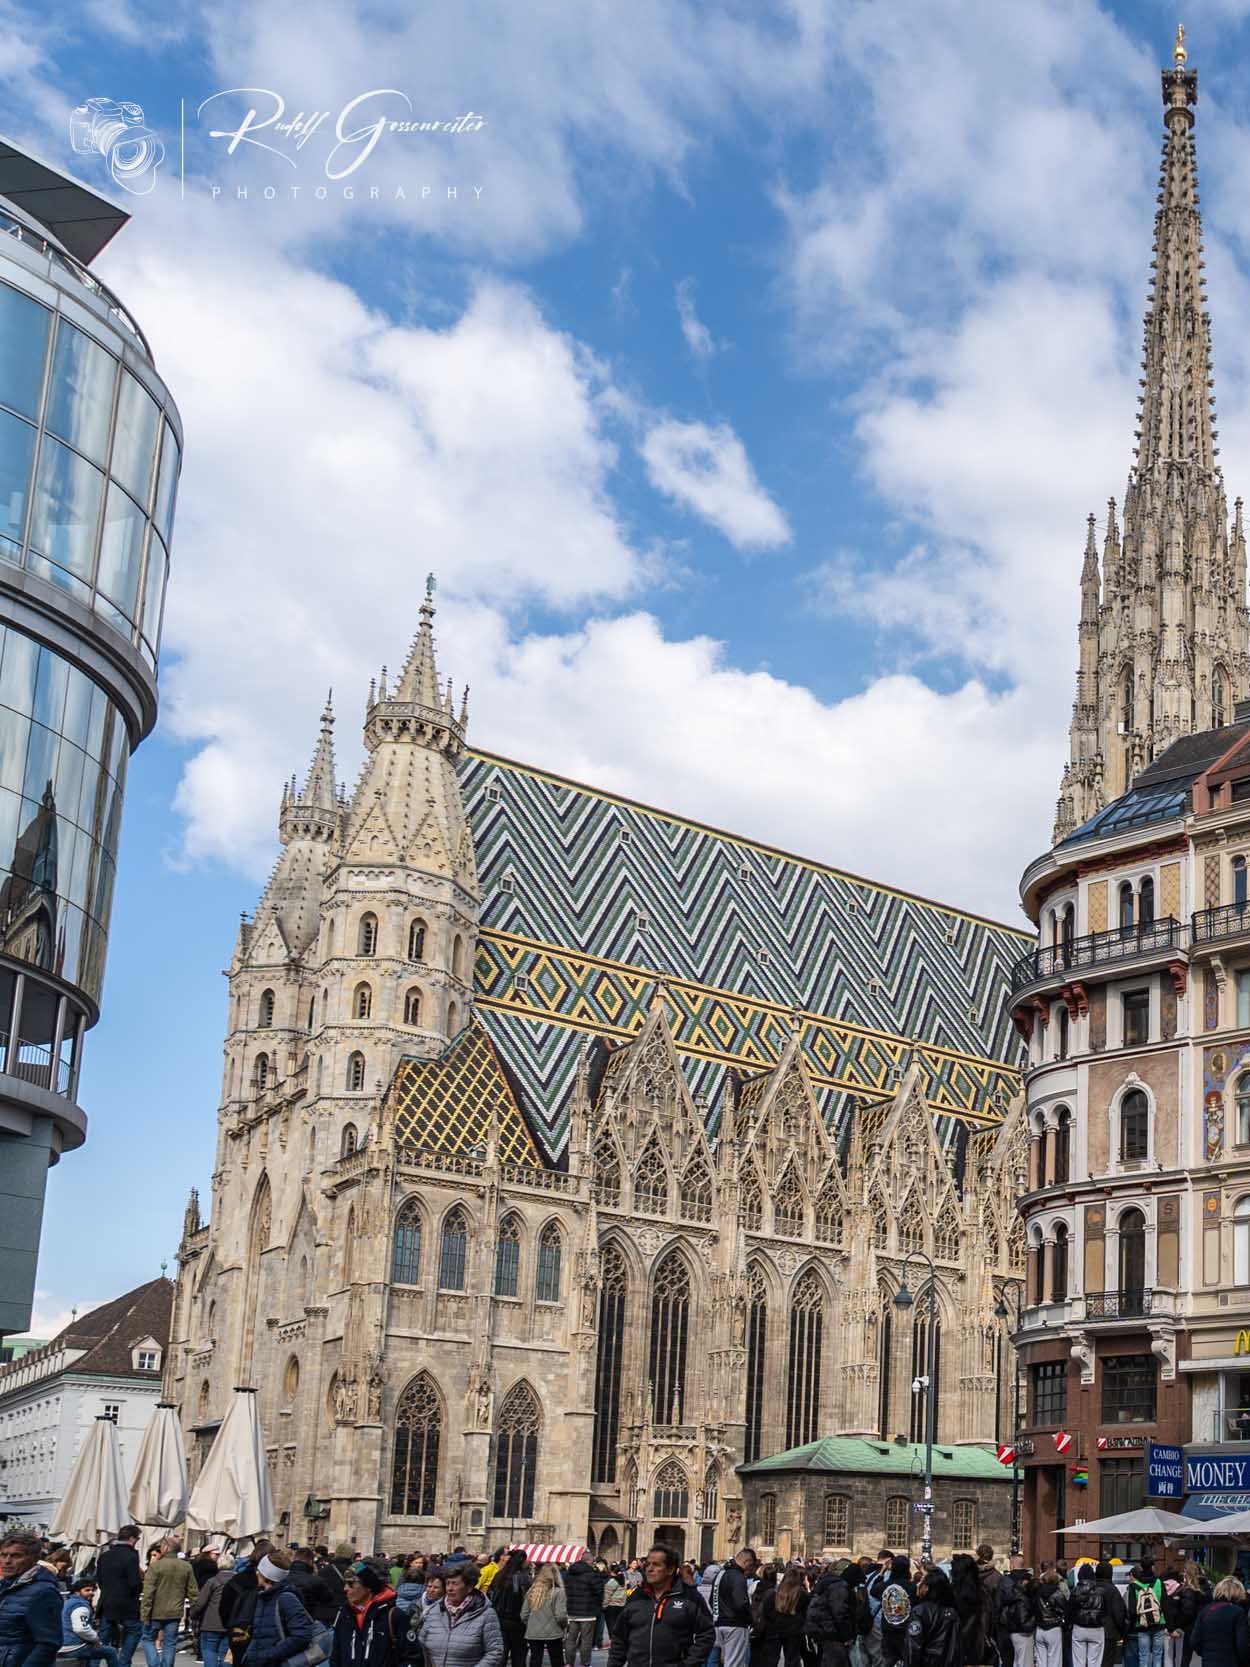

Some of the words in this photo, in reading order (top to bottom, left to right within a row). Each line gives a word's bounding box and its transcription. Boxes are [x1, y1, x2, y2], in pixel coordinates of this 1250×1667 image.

[1153, 1449, 1180, 1460] CAMBIO
[1150, 1463, 1183, 1478] CHANGE
[1187, 1462, 1246, 1487] MONEY
[1200, 1494, 1226, 1504] THE
